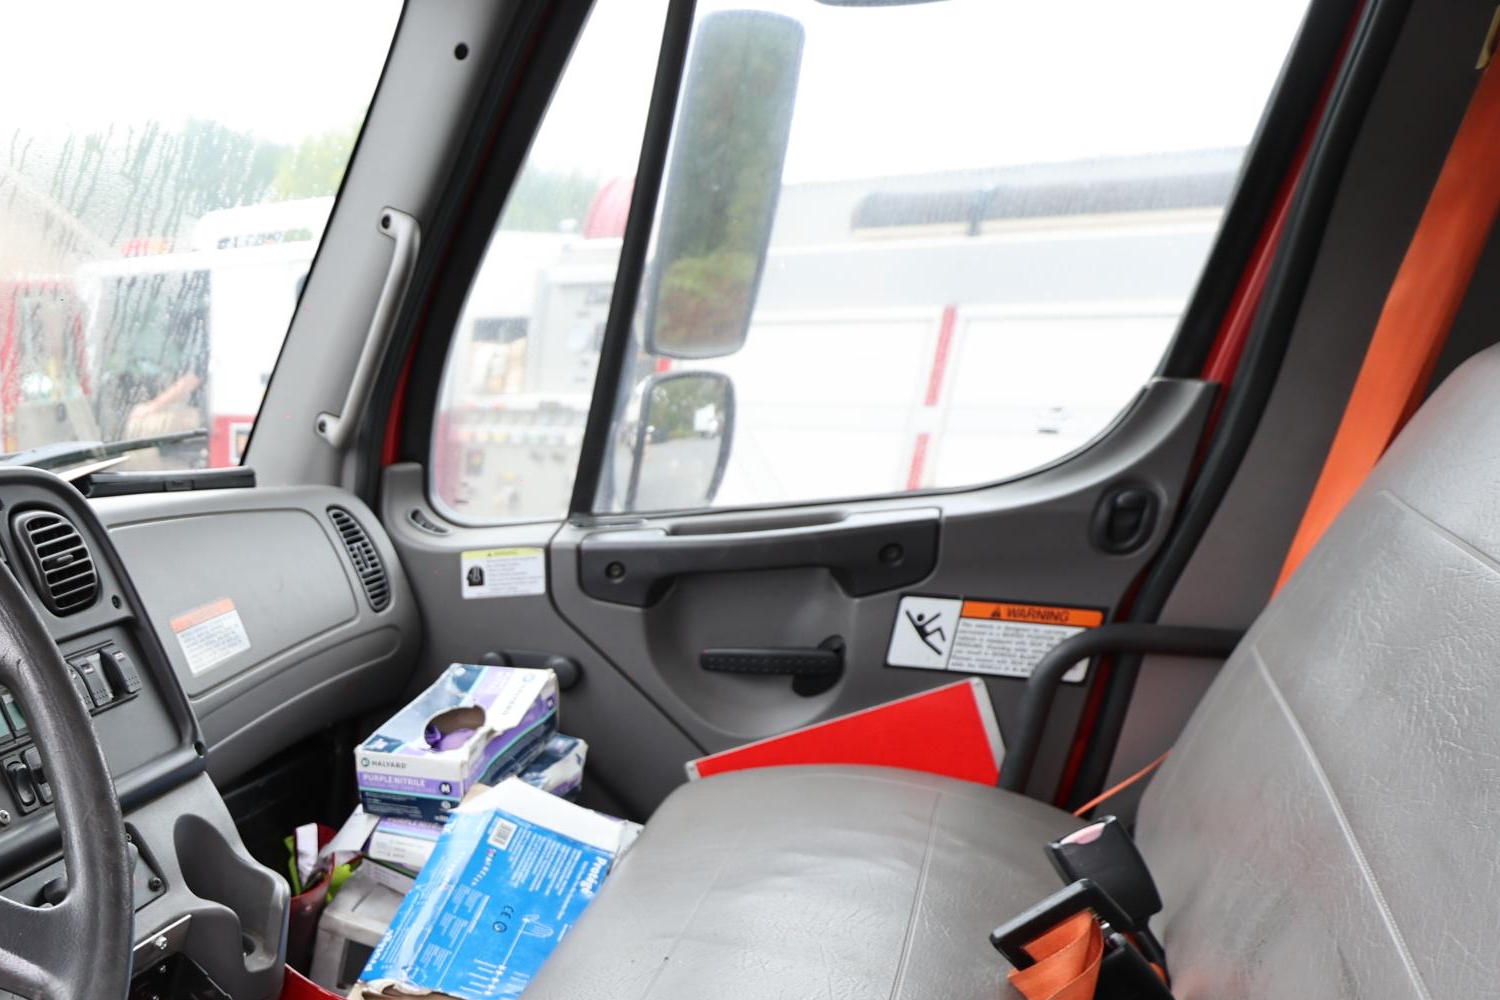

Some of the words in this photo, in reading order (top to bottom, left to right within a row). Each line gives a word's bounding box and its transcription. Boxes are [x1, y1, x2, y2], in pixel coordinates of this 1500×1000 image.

[1007, 606, 1070, 623] WARNING
[363, 774, 393, 784] PURPLE
[394, 776, 425, 787] NITRILE
